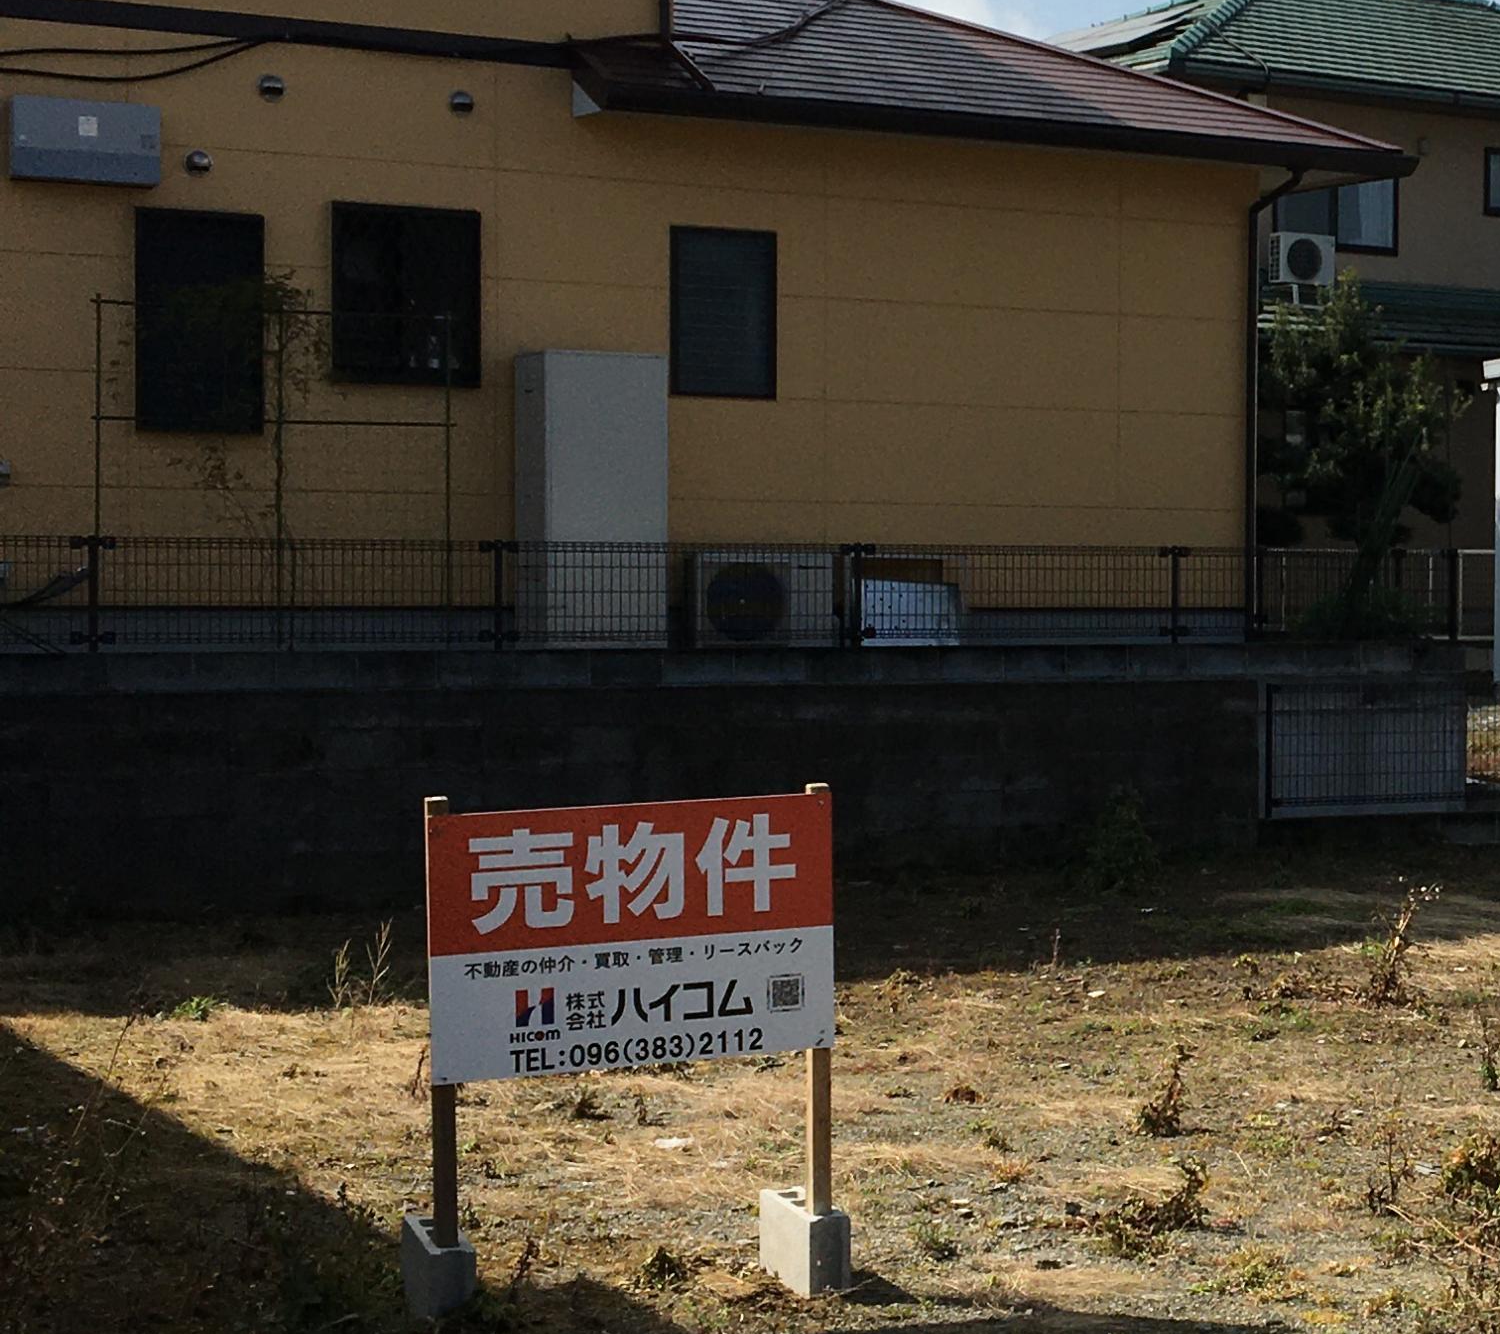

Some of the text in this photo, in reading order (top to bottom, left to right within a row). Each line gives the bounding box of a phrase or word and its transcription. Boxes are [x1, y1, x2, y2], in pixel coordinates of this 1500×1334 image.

[468, 813, 796, 935] 売物件
[464, 937, 803, 980] 不動産の仲介・買取・管理・リースバック
[566, 990, 605, 1011] 株式
[566, 1010, 607, 1031] 会社
[611, 979, 753, 1026] ハイコム
[510, 1027, 763, 1073] TEL:096(383)2112
